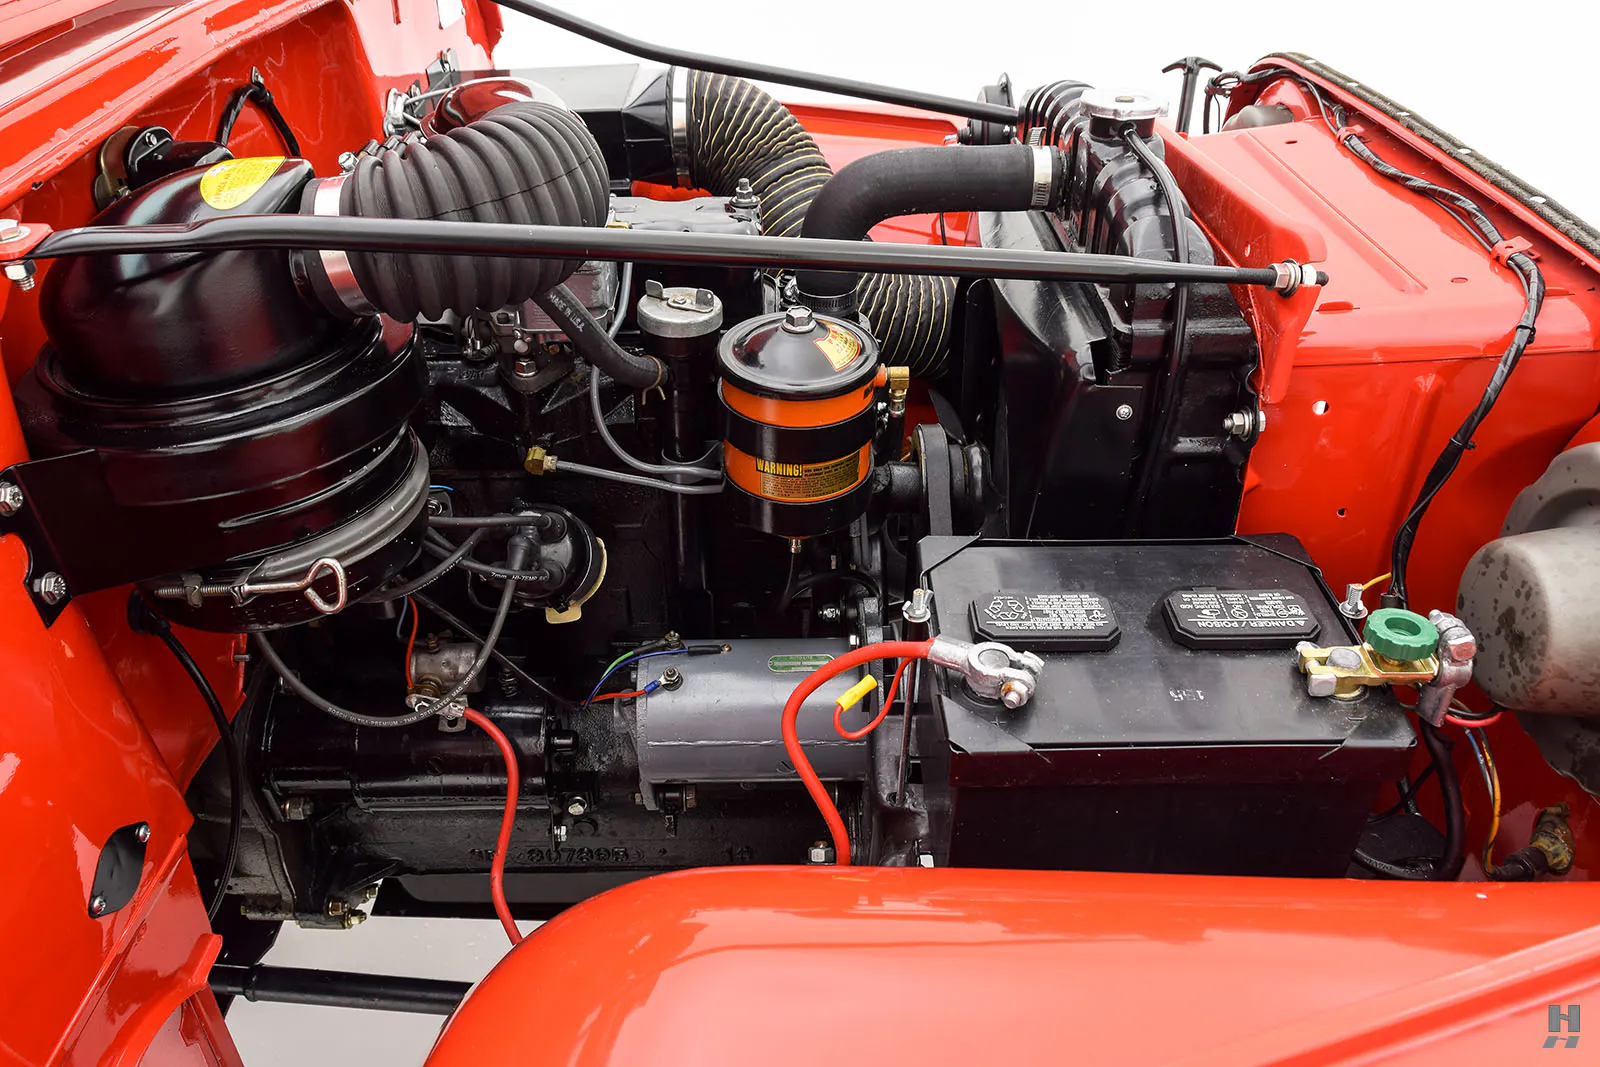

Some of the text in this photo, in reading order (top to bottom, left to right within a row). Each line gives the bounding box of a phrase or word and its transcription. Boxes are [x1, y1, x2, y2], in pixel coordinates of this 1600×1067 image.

[756, 458, 803, 477] WARNING!
[491, 571, 507, 579] 7mm
[1197, 620, 1238, 628] POISON
[1249, 620, 1296, 628] DANGER
[327, 706, 348, 719] BOSCH
[349, 715, 399, 727] ULTRA-PREMIUM
[403, 715, 418, 723] 7MM
[419, 697, 451, 718] OPTI-LAYER
